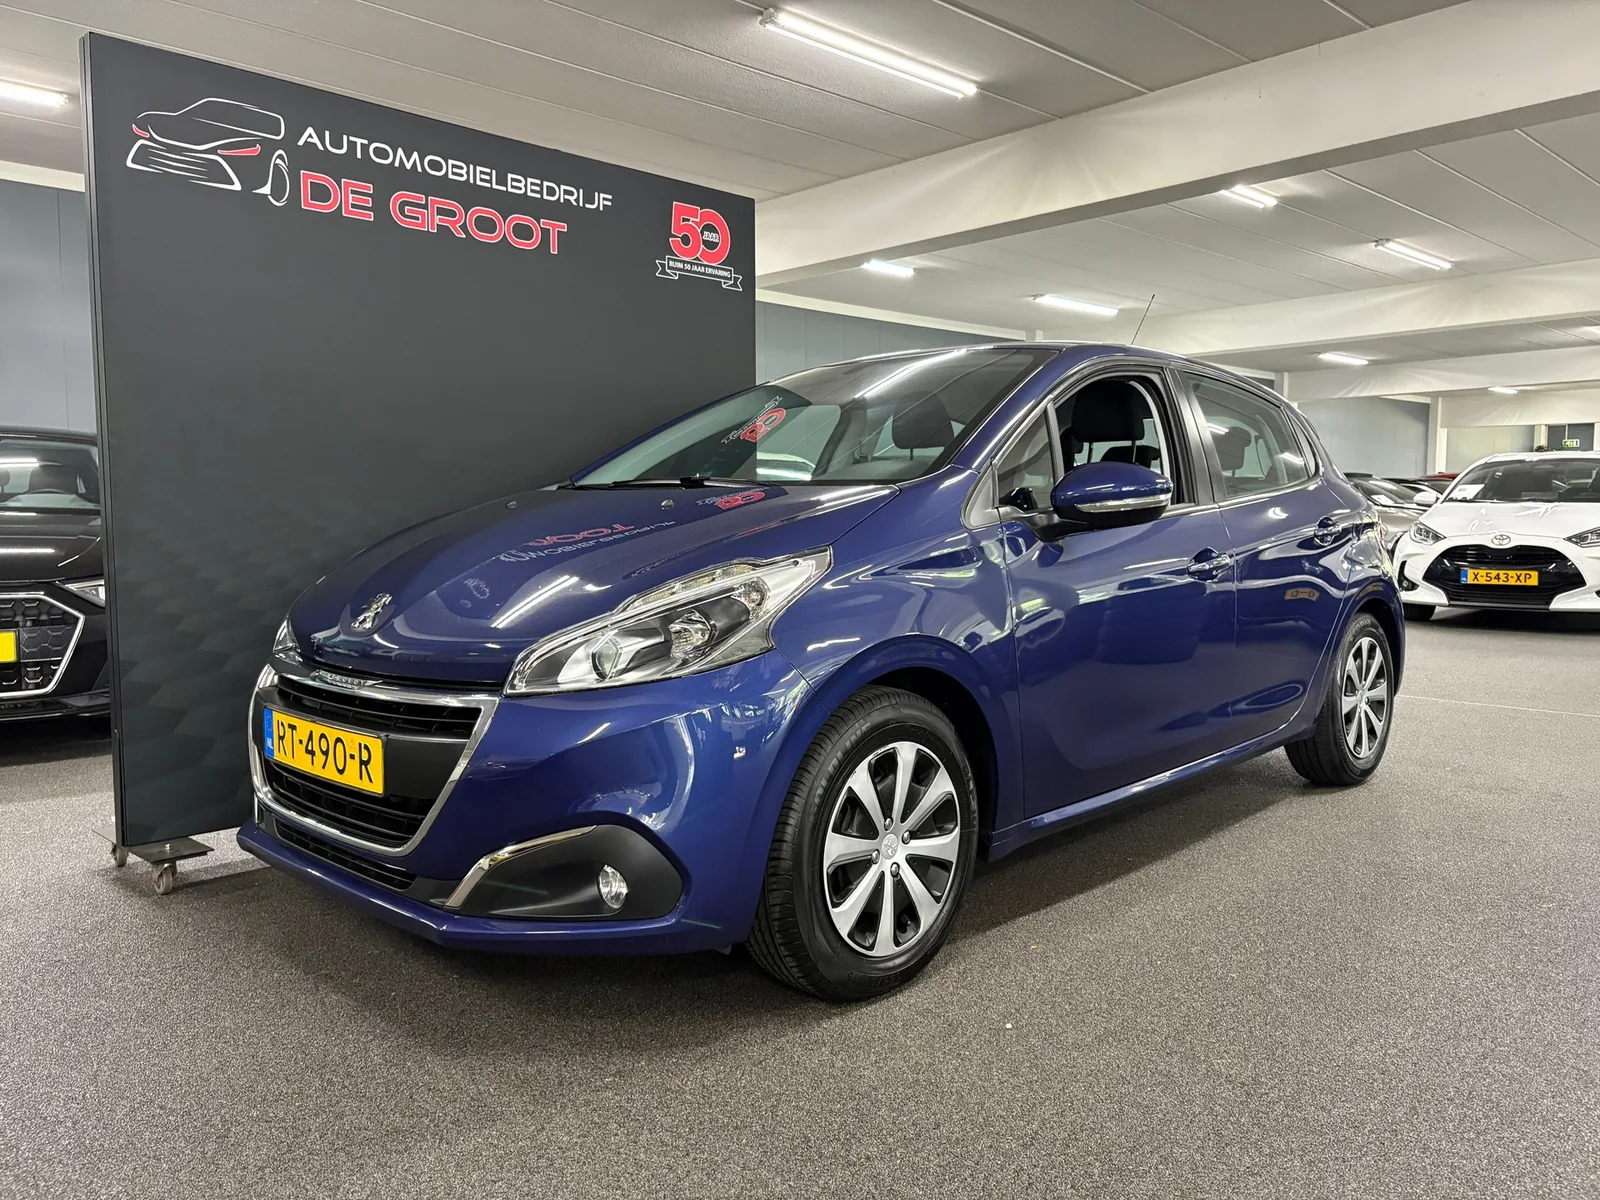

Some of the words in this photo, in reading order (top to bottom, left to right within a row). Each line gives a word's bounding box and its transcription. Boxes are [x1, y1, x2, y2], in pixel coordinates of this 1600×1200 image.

[297, 127, 612, 211] AUTOMOBIELBEDRIJF
[300, 171, 374, 221] DE
[390, 192, 567, 254] GROOT
[669, 202, 730, 266] 50
[702, 231, 719, 243] JAAR
[684, 263, 691, 271] 50
[691, 265, 705, 273] JAAR
[705, 267, 731, 278] ERVARING
[1472, 572, 1532, 583] X-543-XP
[277, 719, 374, 784] RT-490-R
